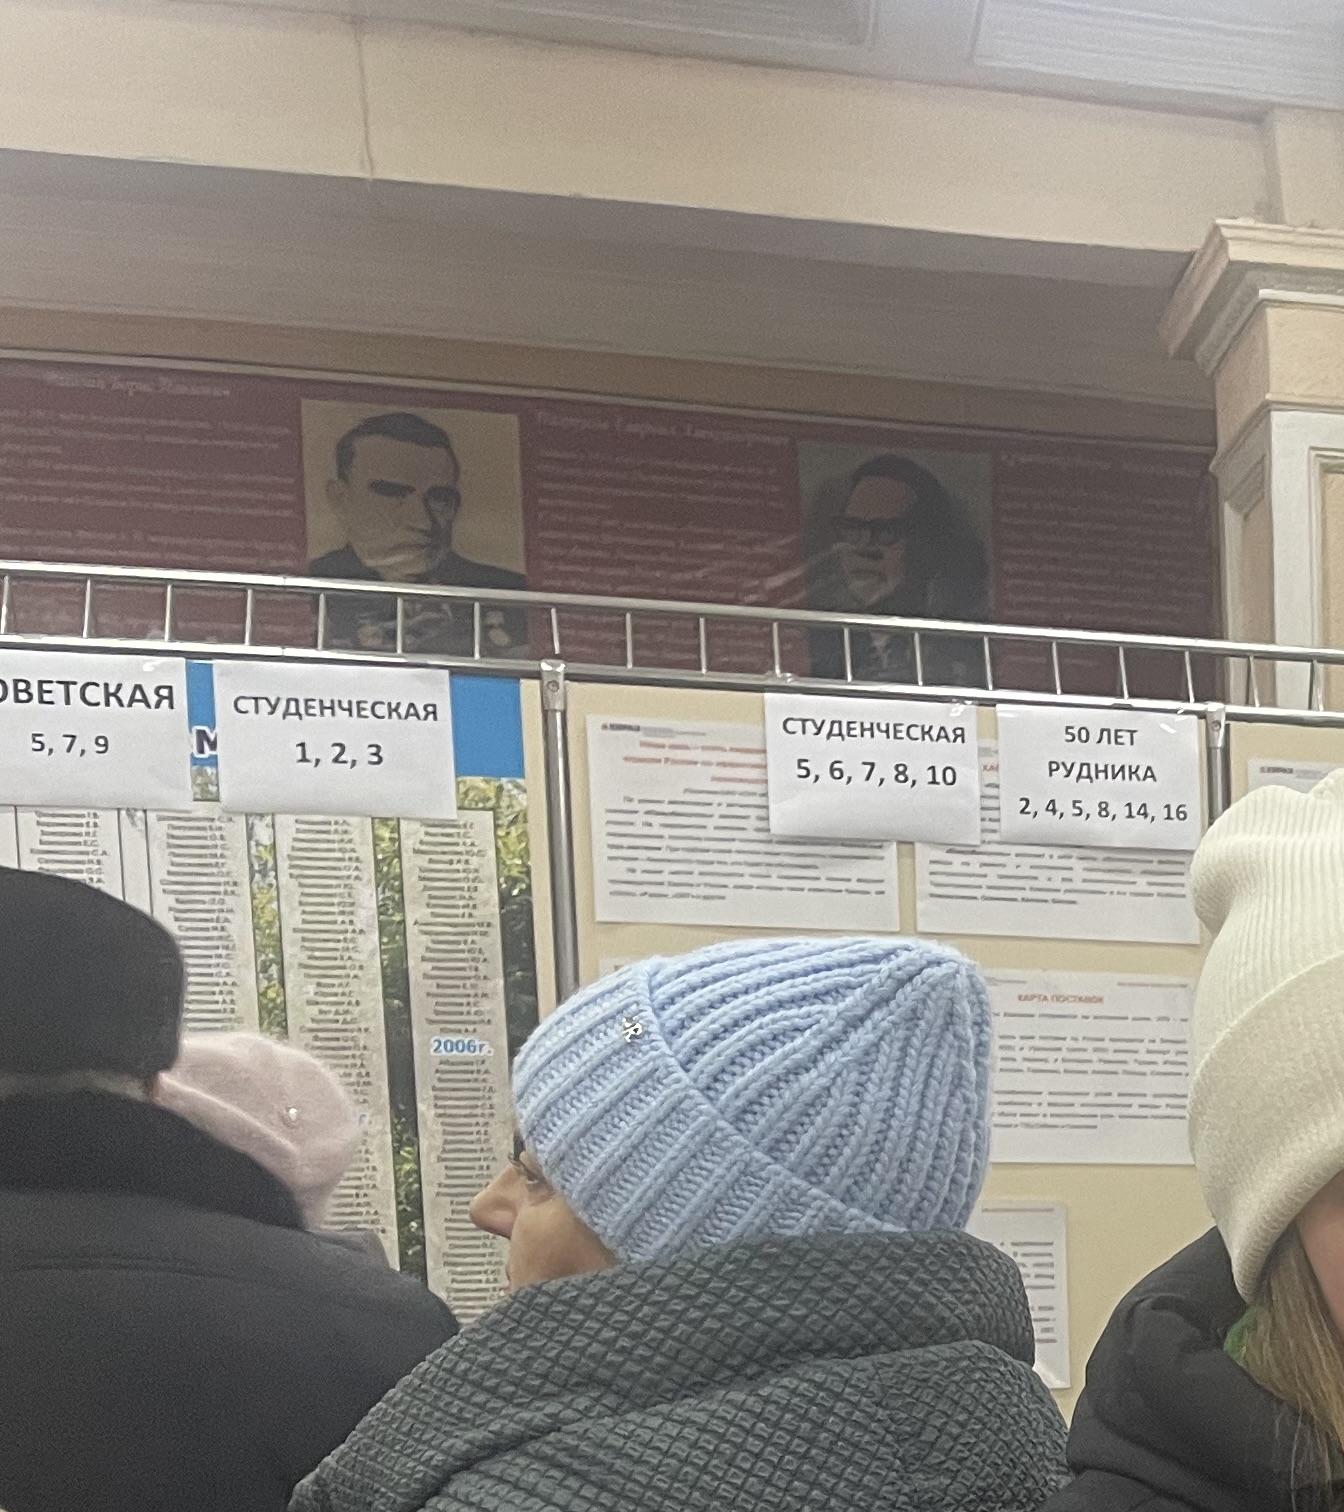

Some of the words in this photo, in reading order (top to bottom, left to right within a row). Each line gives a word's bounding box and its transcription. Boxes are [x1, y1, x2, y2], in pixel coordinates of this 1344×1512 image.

[234, 696, 437, 721] СТУДЕНЧЕСКАЯ
[783, 717, 965, 743] СТУДЕНЧЕСКАЯ
[1065, 726, 1090, 743] 50
[1096, 728, 1138, 746] ЛЕТ
[32, 734, 53, 756] 5,
[63, 734, 85, 757] 7,
[95, 736, 108, 754] 9
[296, 742, 320, 767] 1,
[331, 743, 357, 769] 2,
[368, 744, 383, 765] 3
[797, 759, 819, 783] 5,
[829, 760, 852, 785] 6,
[862, 762, 884, 787] 7,
[894, 764, 916, 788] 8,
[927, 766, 956, 785] 10
[1048, 761, 1157, 783] РУДНИКА
[1020, 798, 1037, 818] 2,
[1045, 799, 1064, 819] 4,
[1072, 800, 1090, 821] 5,
[1098, 801, 1116, 821] 8,
[1125, 802, 1155, 823] 14,
[1164, 804, 1187, 821] 16
[433, 1038, 492, 1054] 2006г.
